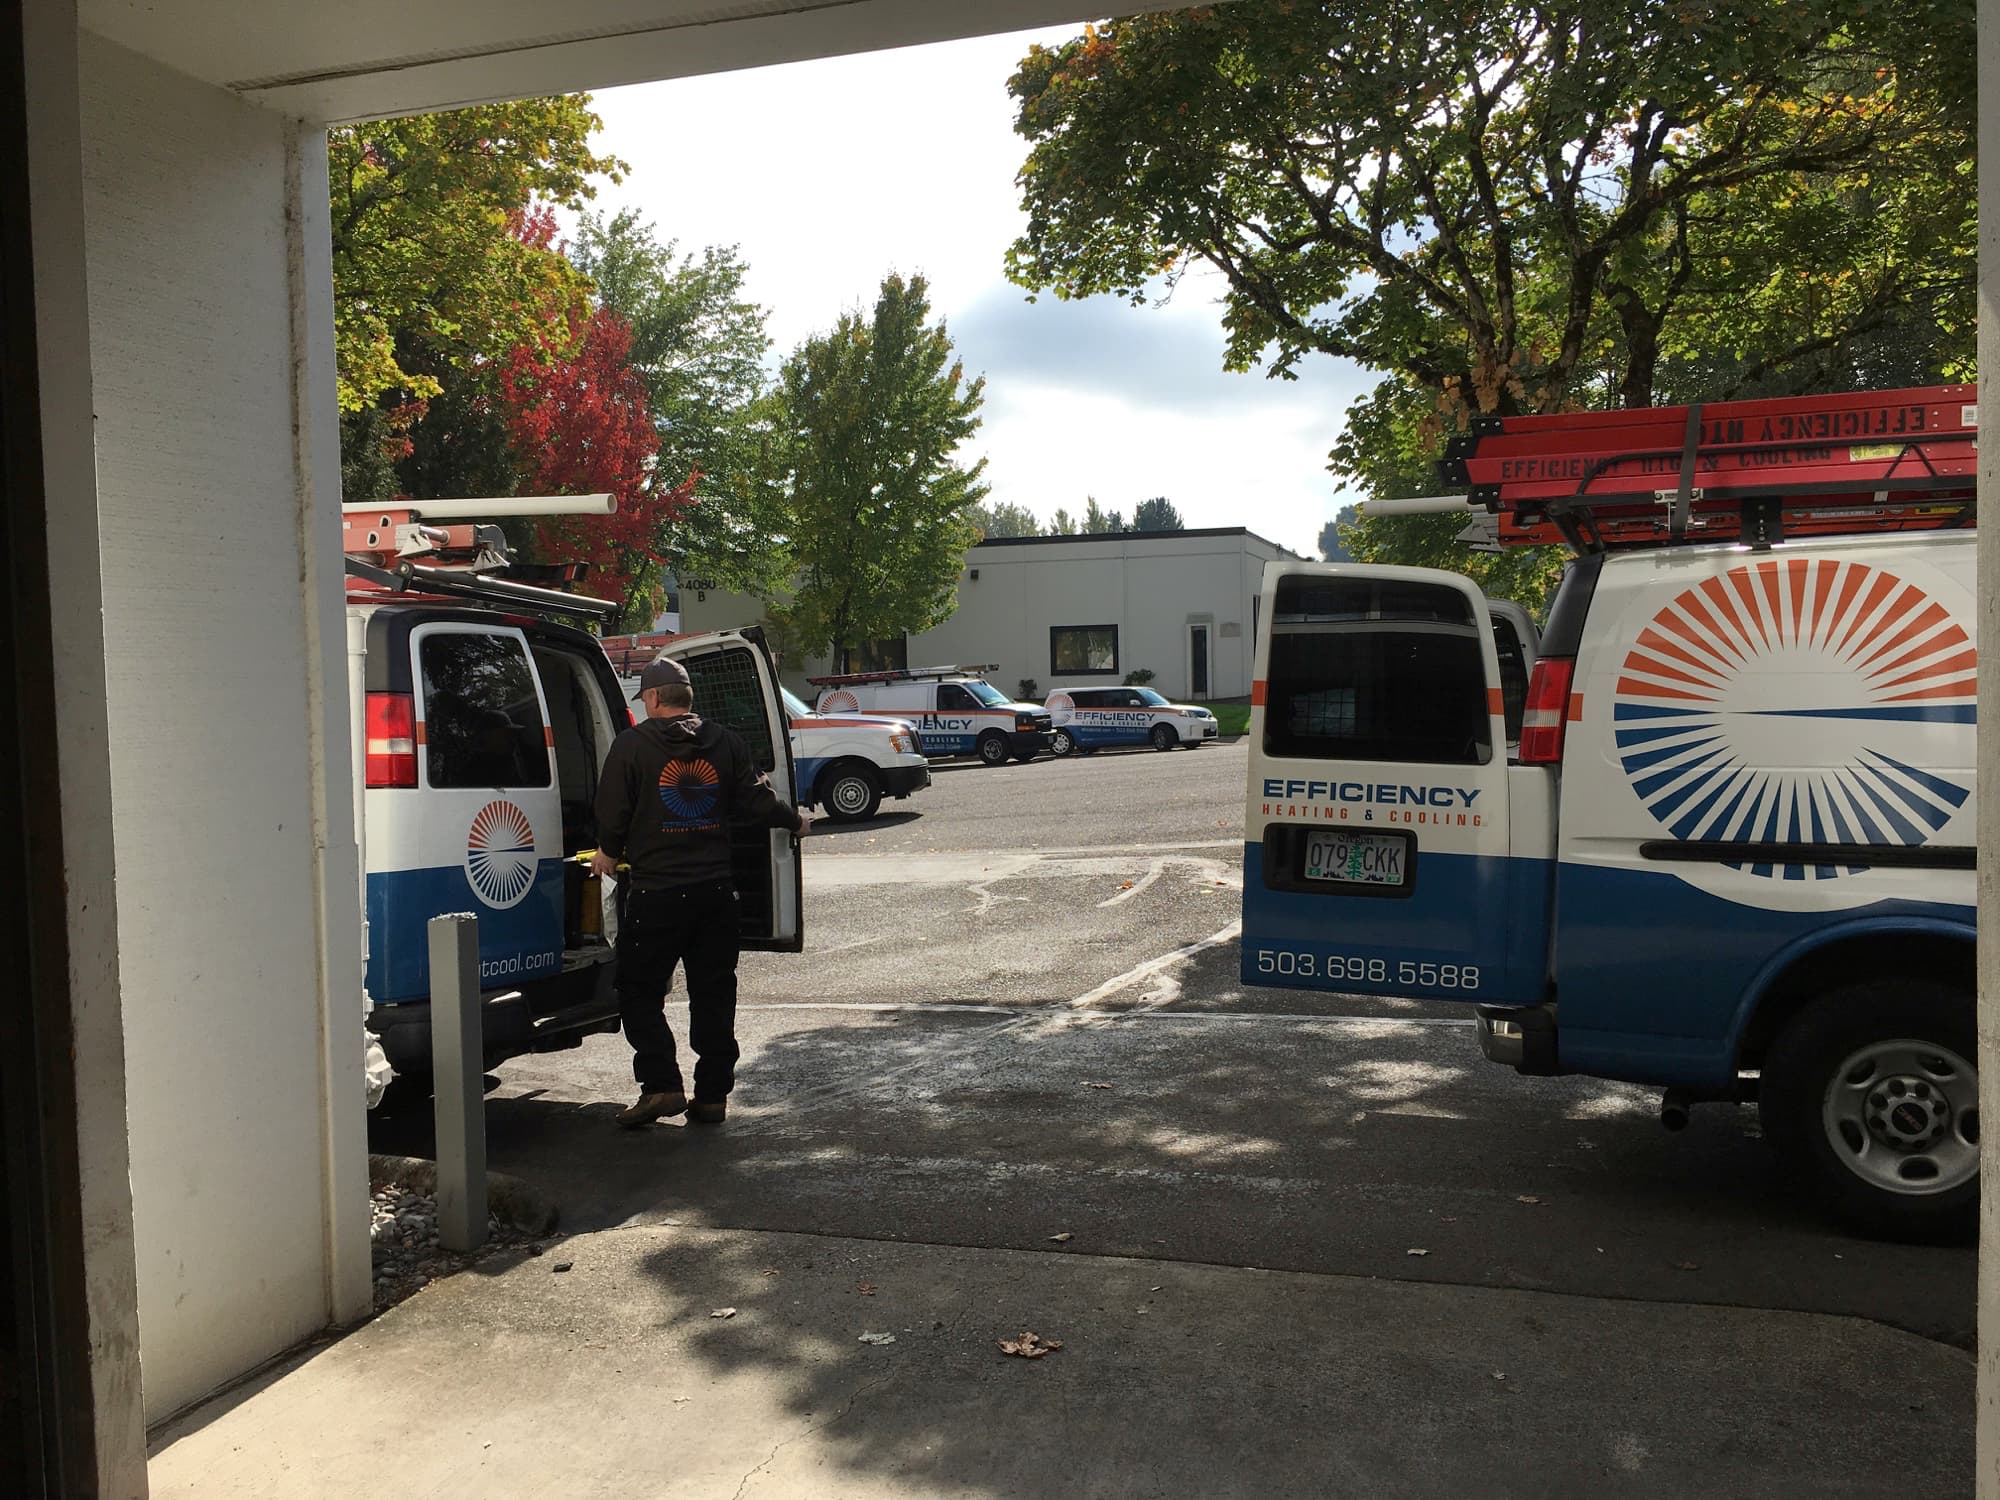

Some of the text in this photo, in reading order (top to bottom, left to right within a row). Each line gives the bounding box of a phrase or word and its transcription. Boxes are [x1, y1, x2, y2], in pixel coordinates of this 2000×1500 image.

[1761, 407, 1926, 441] EFFICIENCY
[698, 591, 706, 602] B
[1075, 711, 1156, 721] EFFICIENCY
[1263, 778, 1482, 808] EFFICIENCY
[1262, 803, 1481, 827] HEATING & COOLING
[1311, 842, 1400, 873] 079 CKK
[479, 952, 554, 977] tcool.com
[1258, 950, 1479, 990] 503.698.5588
